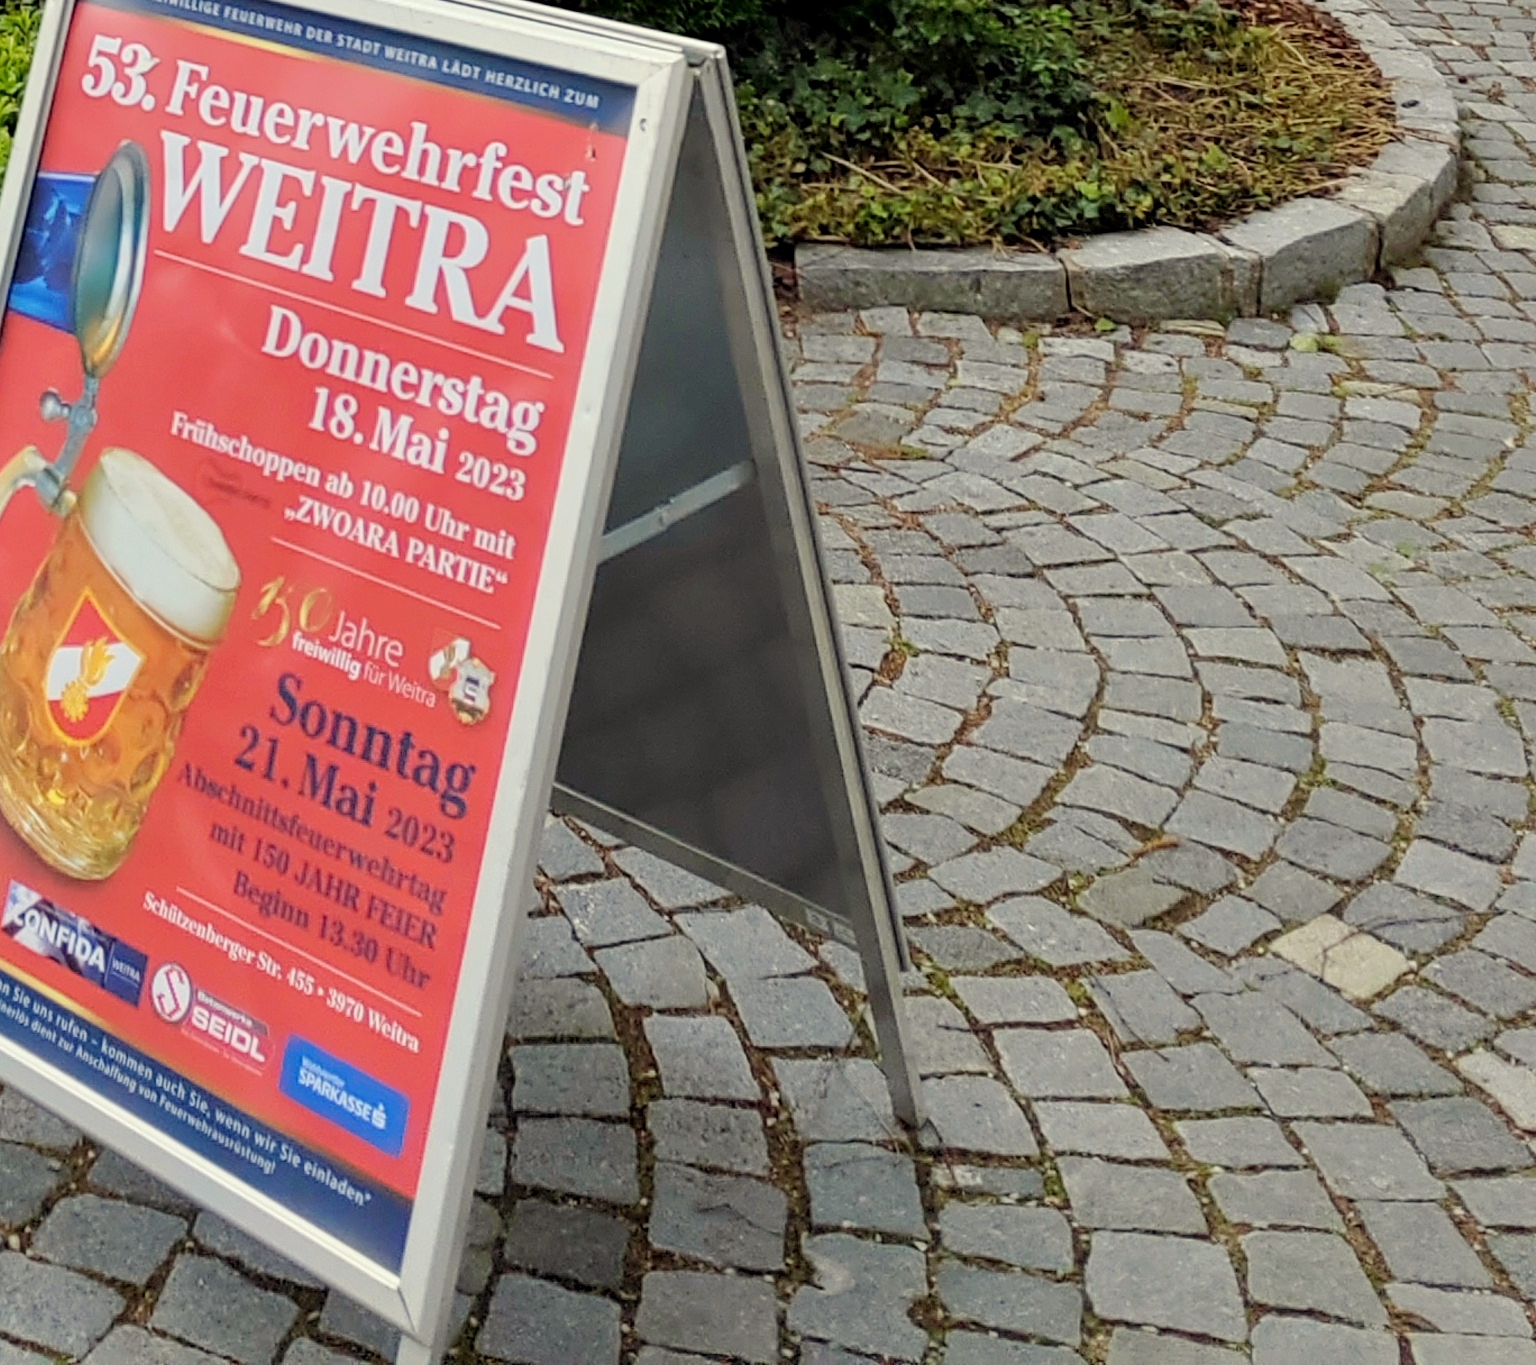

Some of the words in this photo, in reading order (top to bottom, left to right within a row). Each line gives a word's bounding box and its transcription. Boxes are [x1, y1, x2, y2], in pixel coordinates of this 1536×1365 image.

[224, 6, 302, 36] FEUERWEHR
[306, 25, 333, 44] DER
[336, 34, 381, 56] STADT
[384, 45, 438, 68] WEITRA
[442, 57, 481, 80] LÄDT
[485, 70, 560, 99] HERZLICH
[562, 88, 600, 109] ZUM
[81, 33, 160, 112] 53.
[165, 58, 590, 227] Feuerwehrfest
[159, 130, 566, 354] WEITRA
[261, 304, 545, 456] Donnerstag
[308, 386, 364, 445] 18.
[369, 405, 450, 474] Mai
[455, 452, 526, 502] 2023
[170, 411, 321, 488] Frühschoppen
[325, 470, 354, 498] ab
[361, 480, 419, 523] 10.00
[425, 502, 470, 542] Uhr
[473, 528, 516, 559] mit
[292, 631, 362, 680] freiwillig
[364, 663, 386, 686] für
[389, 671, 436, 708] Weitra
[329, 610, 404, 668] Jahre
[234, 725, 289, 790] 21.
[298, 753, 378, 828] Mai
[384, 807, 456, 864] 2023
[270, 672, 475, 820] Sonntag
[177, 763, 447, 916] Abschnittsfeuerwehrtag
[209, 822, 245, 854] mit
[253, 838, 290, 874] 150
[294, 861, 361, 912] JAHR
[367, 895, 438, 949] FEIER
[112, 958, 141, 983] WEITRA
[143, 891, 255, 964] Schützenberger
[256, 951, 282, 980] Str.
[287, 967, 315, 997] 455
[327, 988, 364, 1023] 3970
[368, 1010, 421, 1054] Weitra
[233, 870, 309, 929] Beginn
[319, 914, 379, 964] 13.30
[386, 947, 430, 990] Uhr
[13, 981, 30, 1006] Sie
[33, 1000, 53, 1023] uns
[56, 1012, 88, 1043] rufen
[101, 1036, 153, 1081] kommen
[156, 1075, 186, 1102] auch
[189, 1090, 211, 1118] Sie,
[215, 1108, 251, 1139] wenn
[254, 1130, 277, 1155] wir
[280, 1140, 301, 1168] Sie
[31, 1019, 57, 1042] dient
[57, 1039, 74, 1052] zur
[75, 1045, 136, 1094] Anschaffung
[138, 1085, 158, 1103] von
[159, 1091, 277, 1175] Feuerwehrausrüstung!
[191, 1005, 265, 1063] SEIDL
[298, 1067, 372, 1123] SPARKASSE
